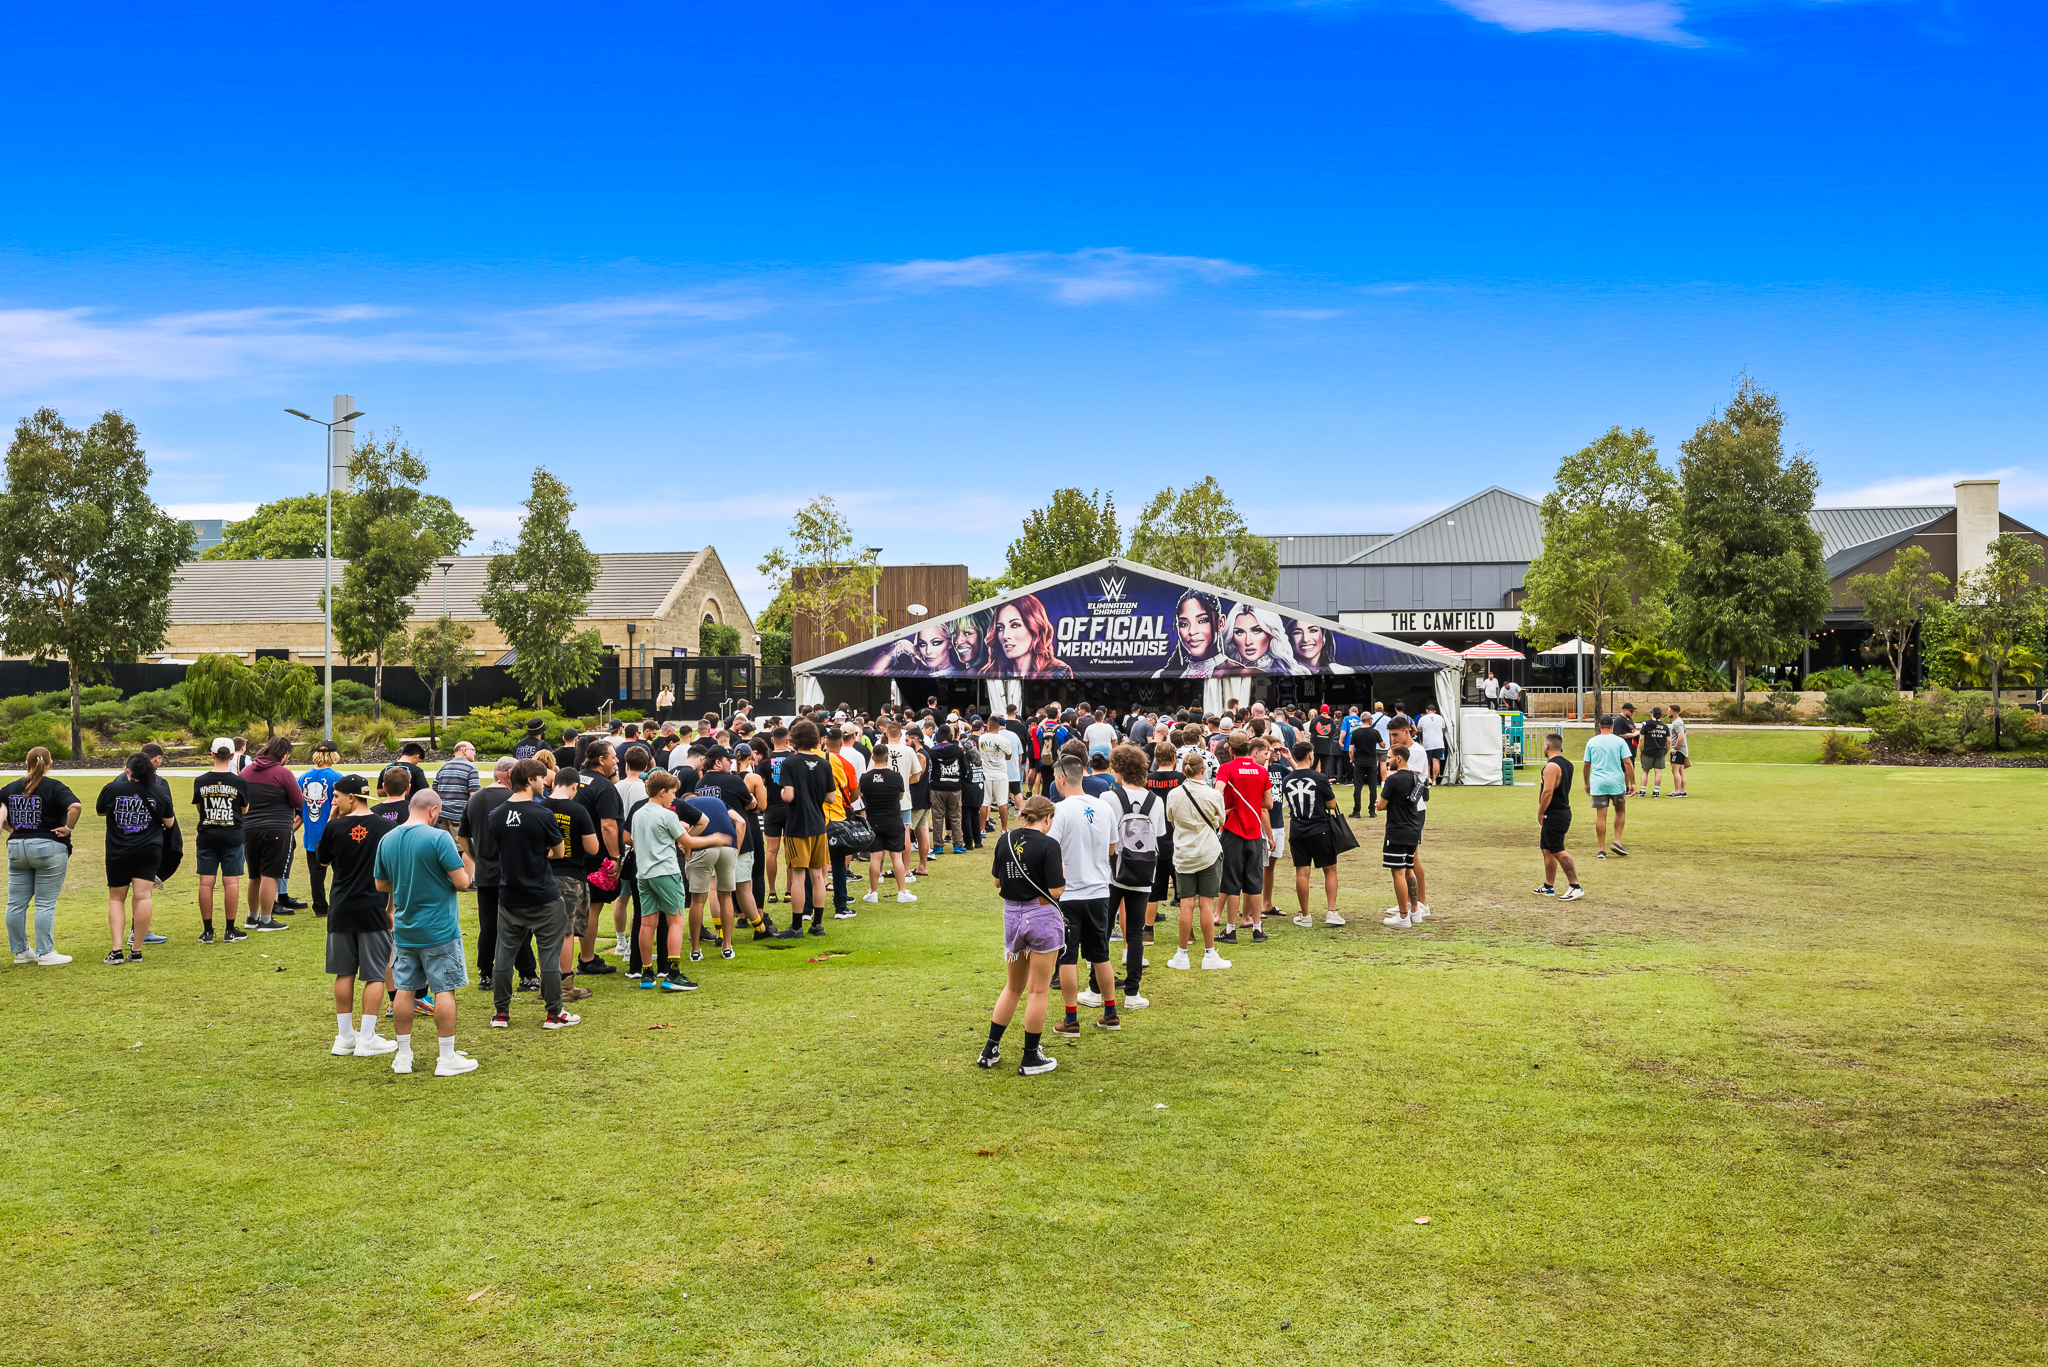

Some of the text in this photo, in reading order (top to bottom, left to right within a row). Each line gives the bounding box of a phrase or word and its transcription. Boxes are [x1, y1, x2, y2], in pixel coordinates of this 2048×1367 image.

[1087, 602, 1138, 610] ELIMINATION
[1057, 615, 1169, 641] OFFICIAL
[1391, 612, 1495, 631] THE CAMFIELD
[1057, 640, 1169, 657] MERCHANDISE
[1147, 778, 1179, 789] ALWAYS
[204, 797, 234, 809] I WAS
[205, 808, 234, 821] THERE
